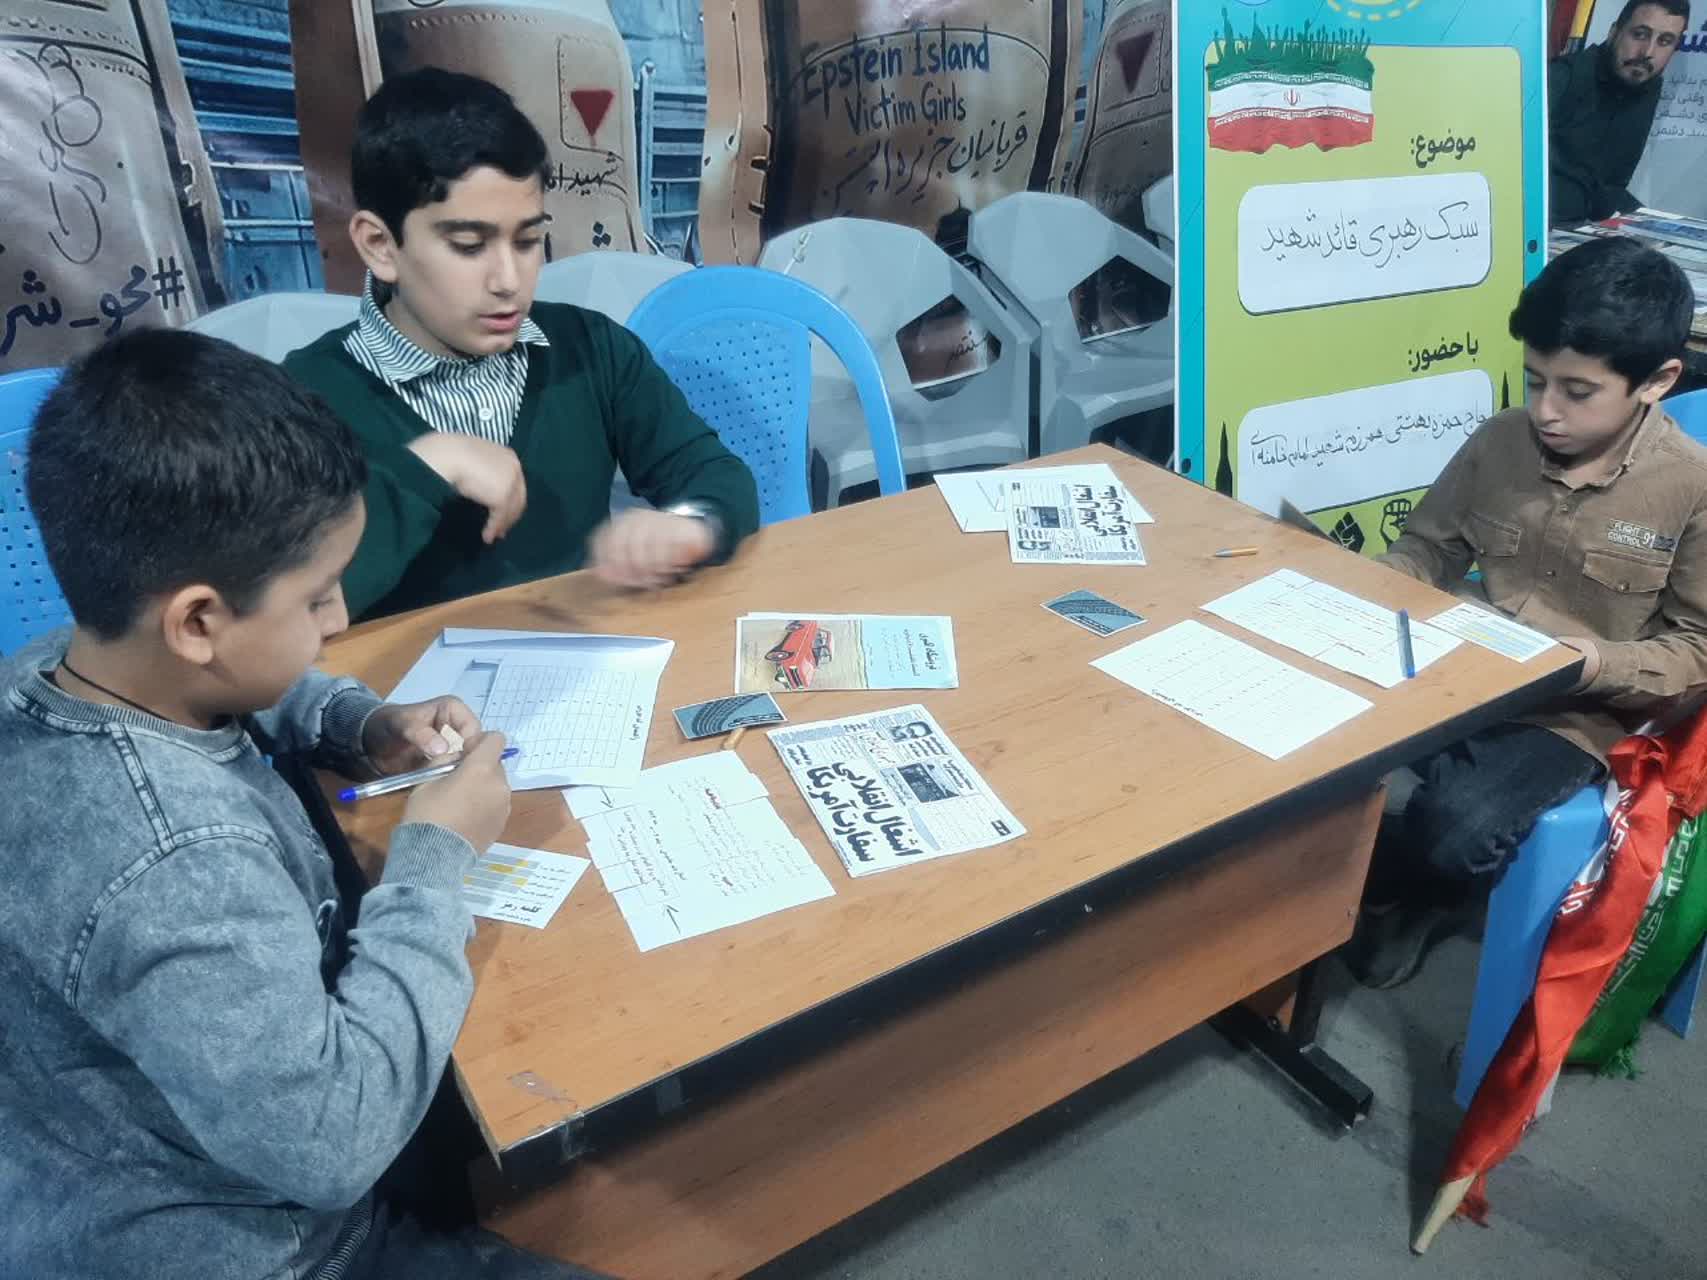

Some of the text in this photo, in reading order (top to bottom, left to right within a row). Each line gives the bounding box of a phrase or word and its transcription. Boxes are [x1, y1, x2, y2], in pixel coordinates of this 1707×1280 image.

[802, 20, 991, 120] Epstein Island
[845, 80, 967, 136] Victim Girls
[946, 110, 1029, 178] قربانیان
[1410, 127, 1477, 169] موضوع:
[1260, 209, 1324, 263] شهید
[1358, 215, 1424, 269] رهبری
[1422, 200, 1480, 254] سبک
[806, 765, 860, 811] آمریکا
[831, 761, 895, 811] انقلابی
[831, 810, 876, 862] سفارت
[862, 810, 924, 857] اشغال
